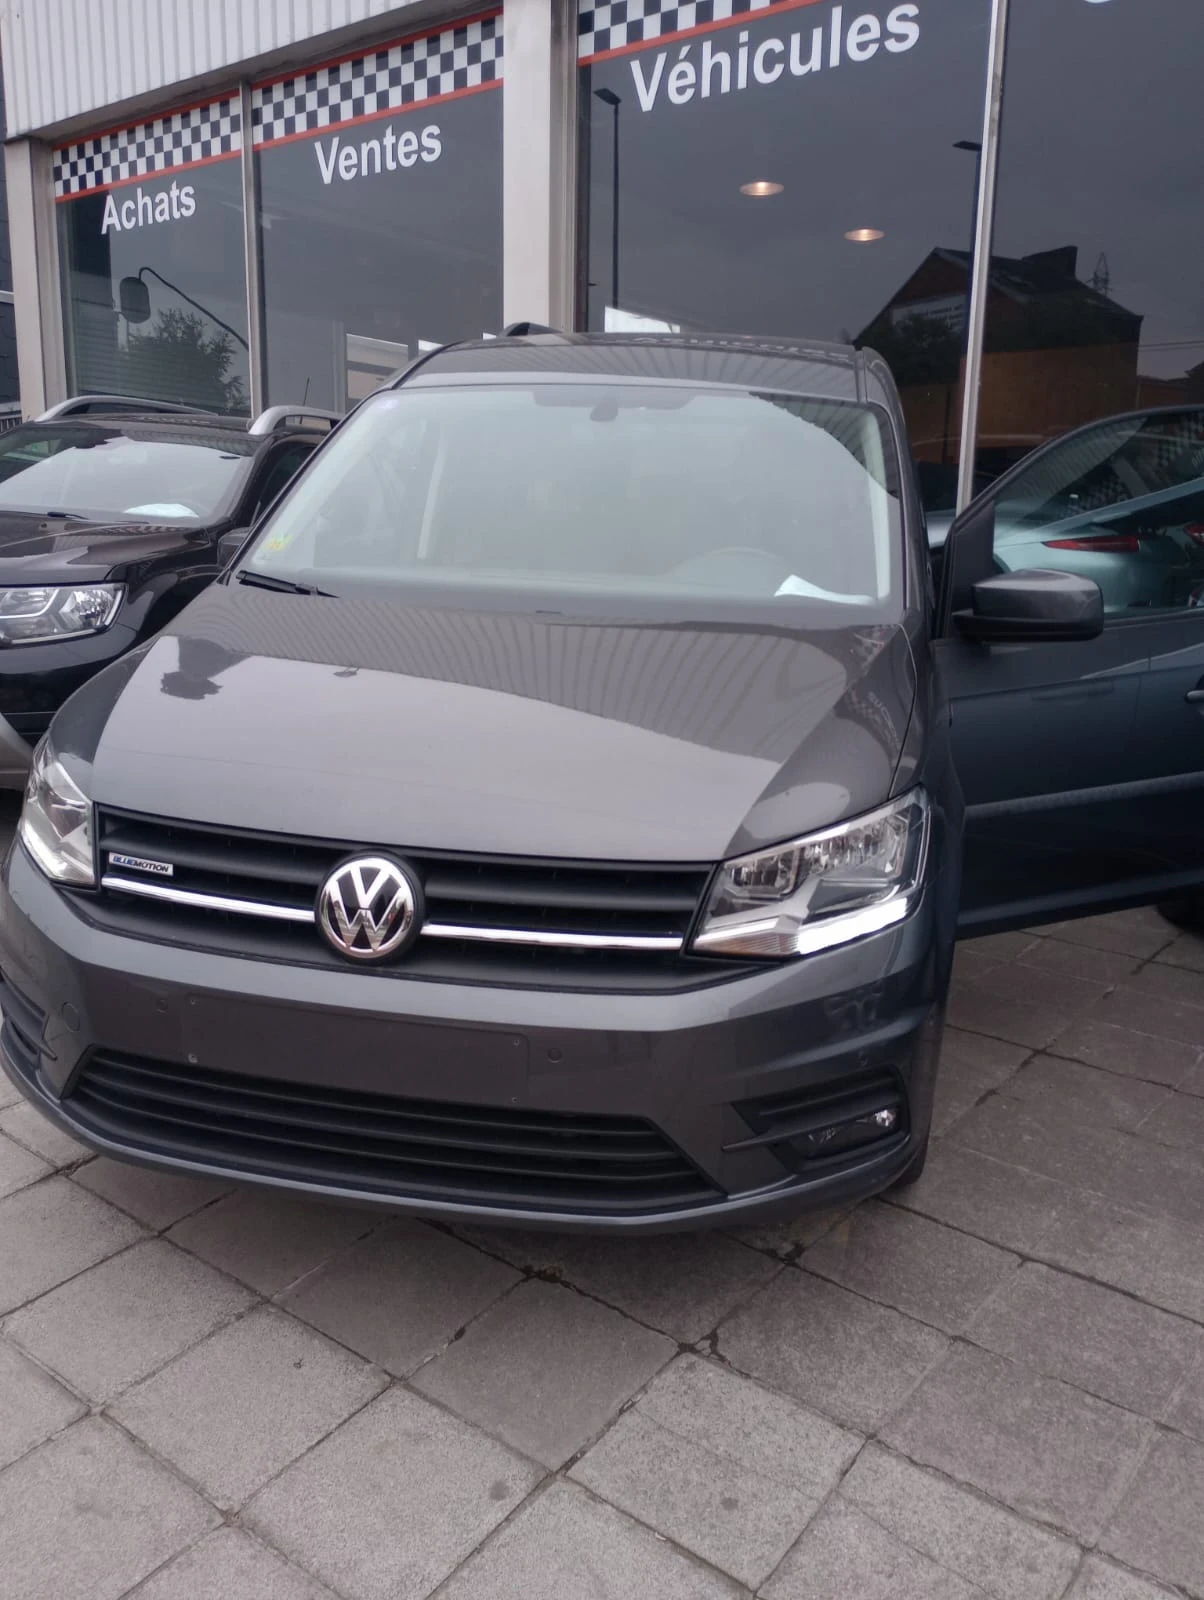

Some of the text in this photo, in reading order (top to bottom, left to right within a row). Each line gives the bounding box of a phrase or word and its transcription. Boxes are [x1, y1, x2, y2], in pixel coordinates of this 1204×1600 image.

[630, 3, 920, 112] Véhicules
[314, 124, 442, 185] Ventes
[101, 181, 196, 235] Achats
